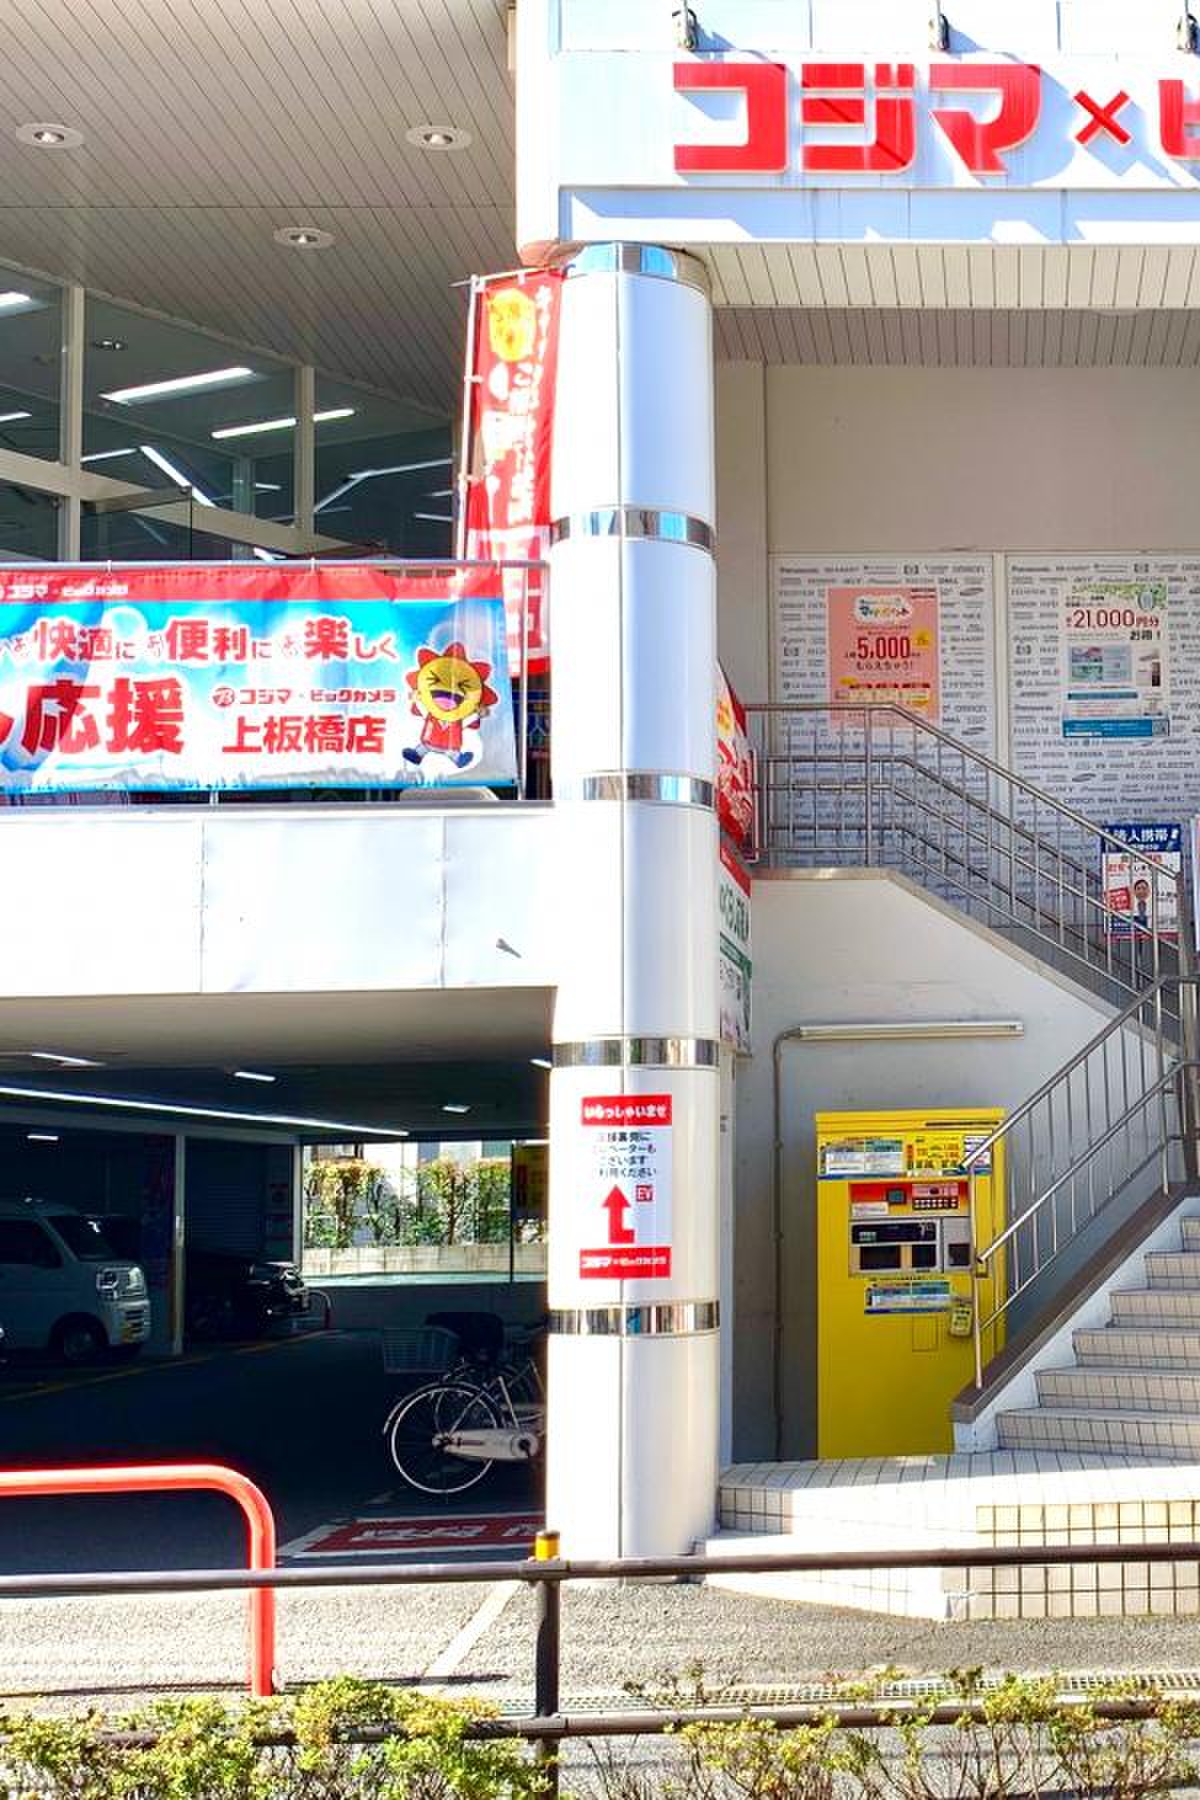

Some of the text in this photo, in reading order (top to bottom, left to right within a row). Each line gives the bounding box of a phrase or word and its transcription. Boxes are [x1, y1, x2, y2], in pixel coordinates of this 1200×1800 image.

[0, 678, 185, 756] 応援
[222, 715, 386, 754] 上板橋店
